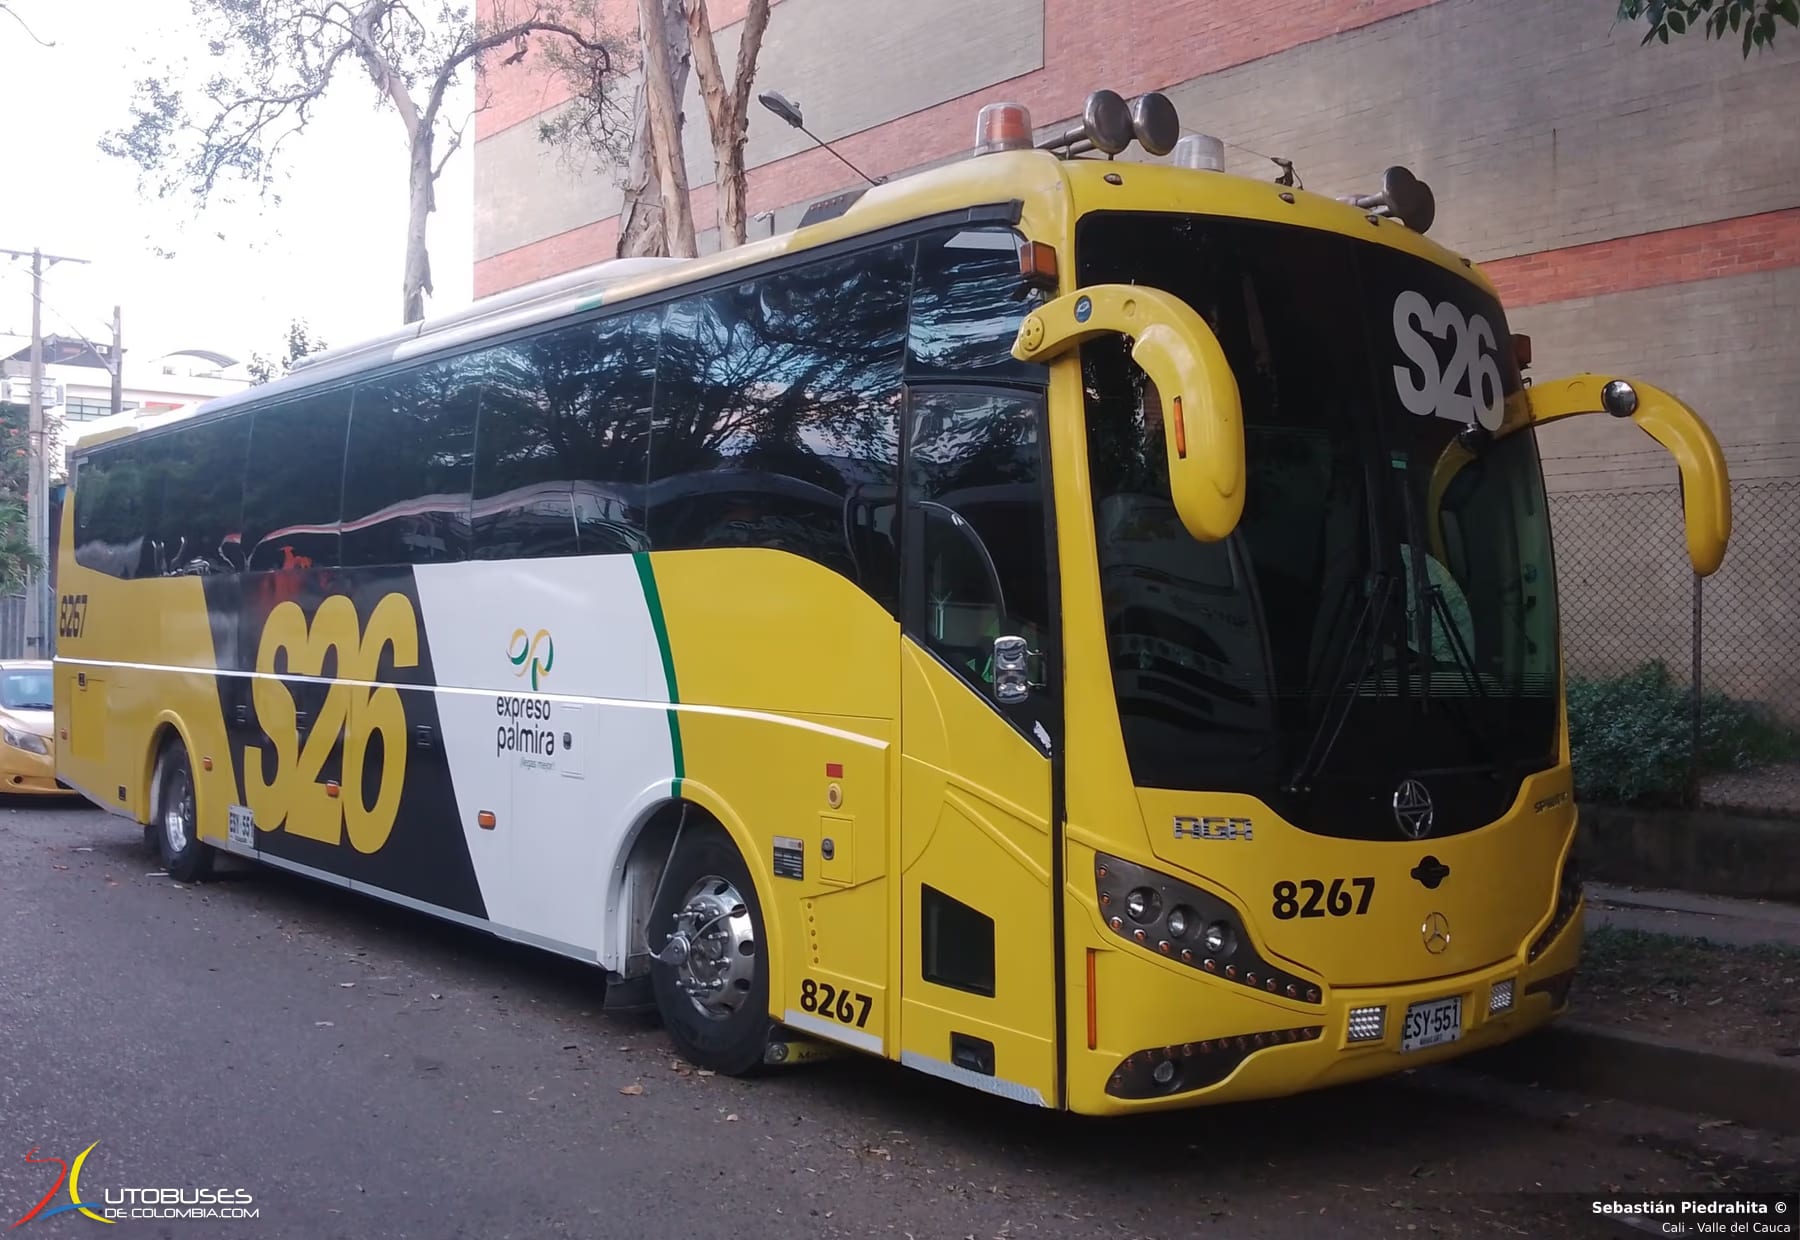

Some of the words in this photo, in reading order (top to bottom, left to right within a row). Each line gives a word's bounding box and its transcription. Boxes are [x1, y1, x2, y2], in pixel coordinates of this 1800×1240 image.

[1393, 290, 1505, 432] S26
[60, 594, 88, 638] 8267
[244, 592, 419, 854] S26
[496, 696, 551, 725] expreso
[497, 721, 555, 758] palmira
[1173, 815, 1253, 841] AGA
[1271, 877, 1376, 920] 8267
[800, 978, 873, 1029] 8267
